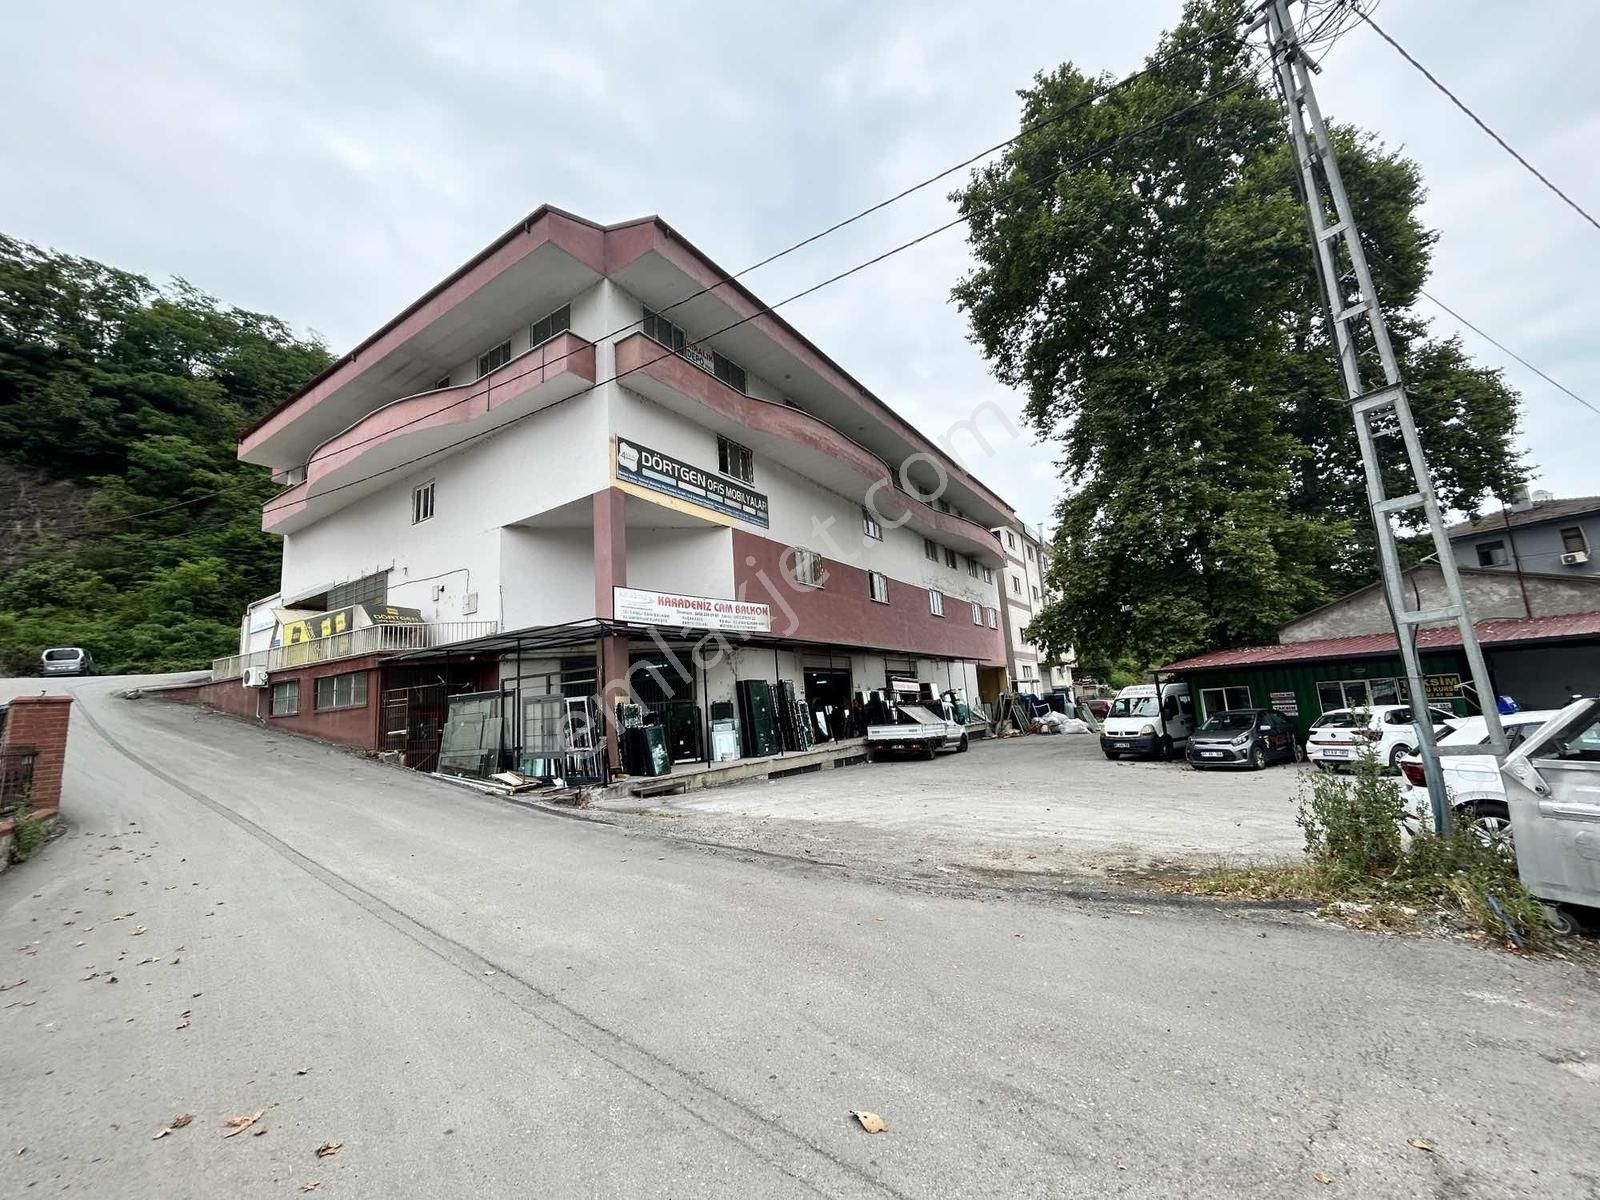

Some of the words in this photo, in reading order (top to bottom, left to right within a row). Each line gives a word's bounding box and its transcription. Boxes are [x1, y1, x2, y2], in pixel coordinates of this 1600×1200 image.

[641, 451, 706, 488] DÖRTGEN
[657, 596, 712, 612] KARADENİZ
[714, 602, 733, 613] CAM
[735, 606, 769, 616] BALKON
